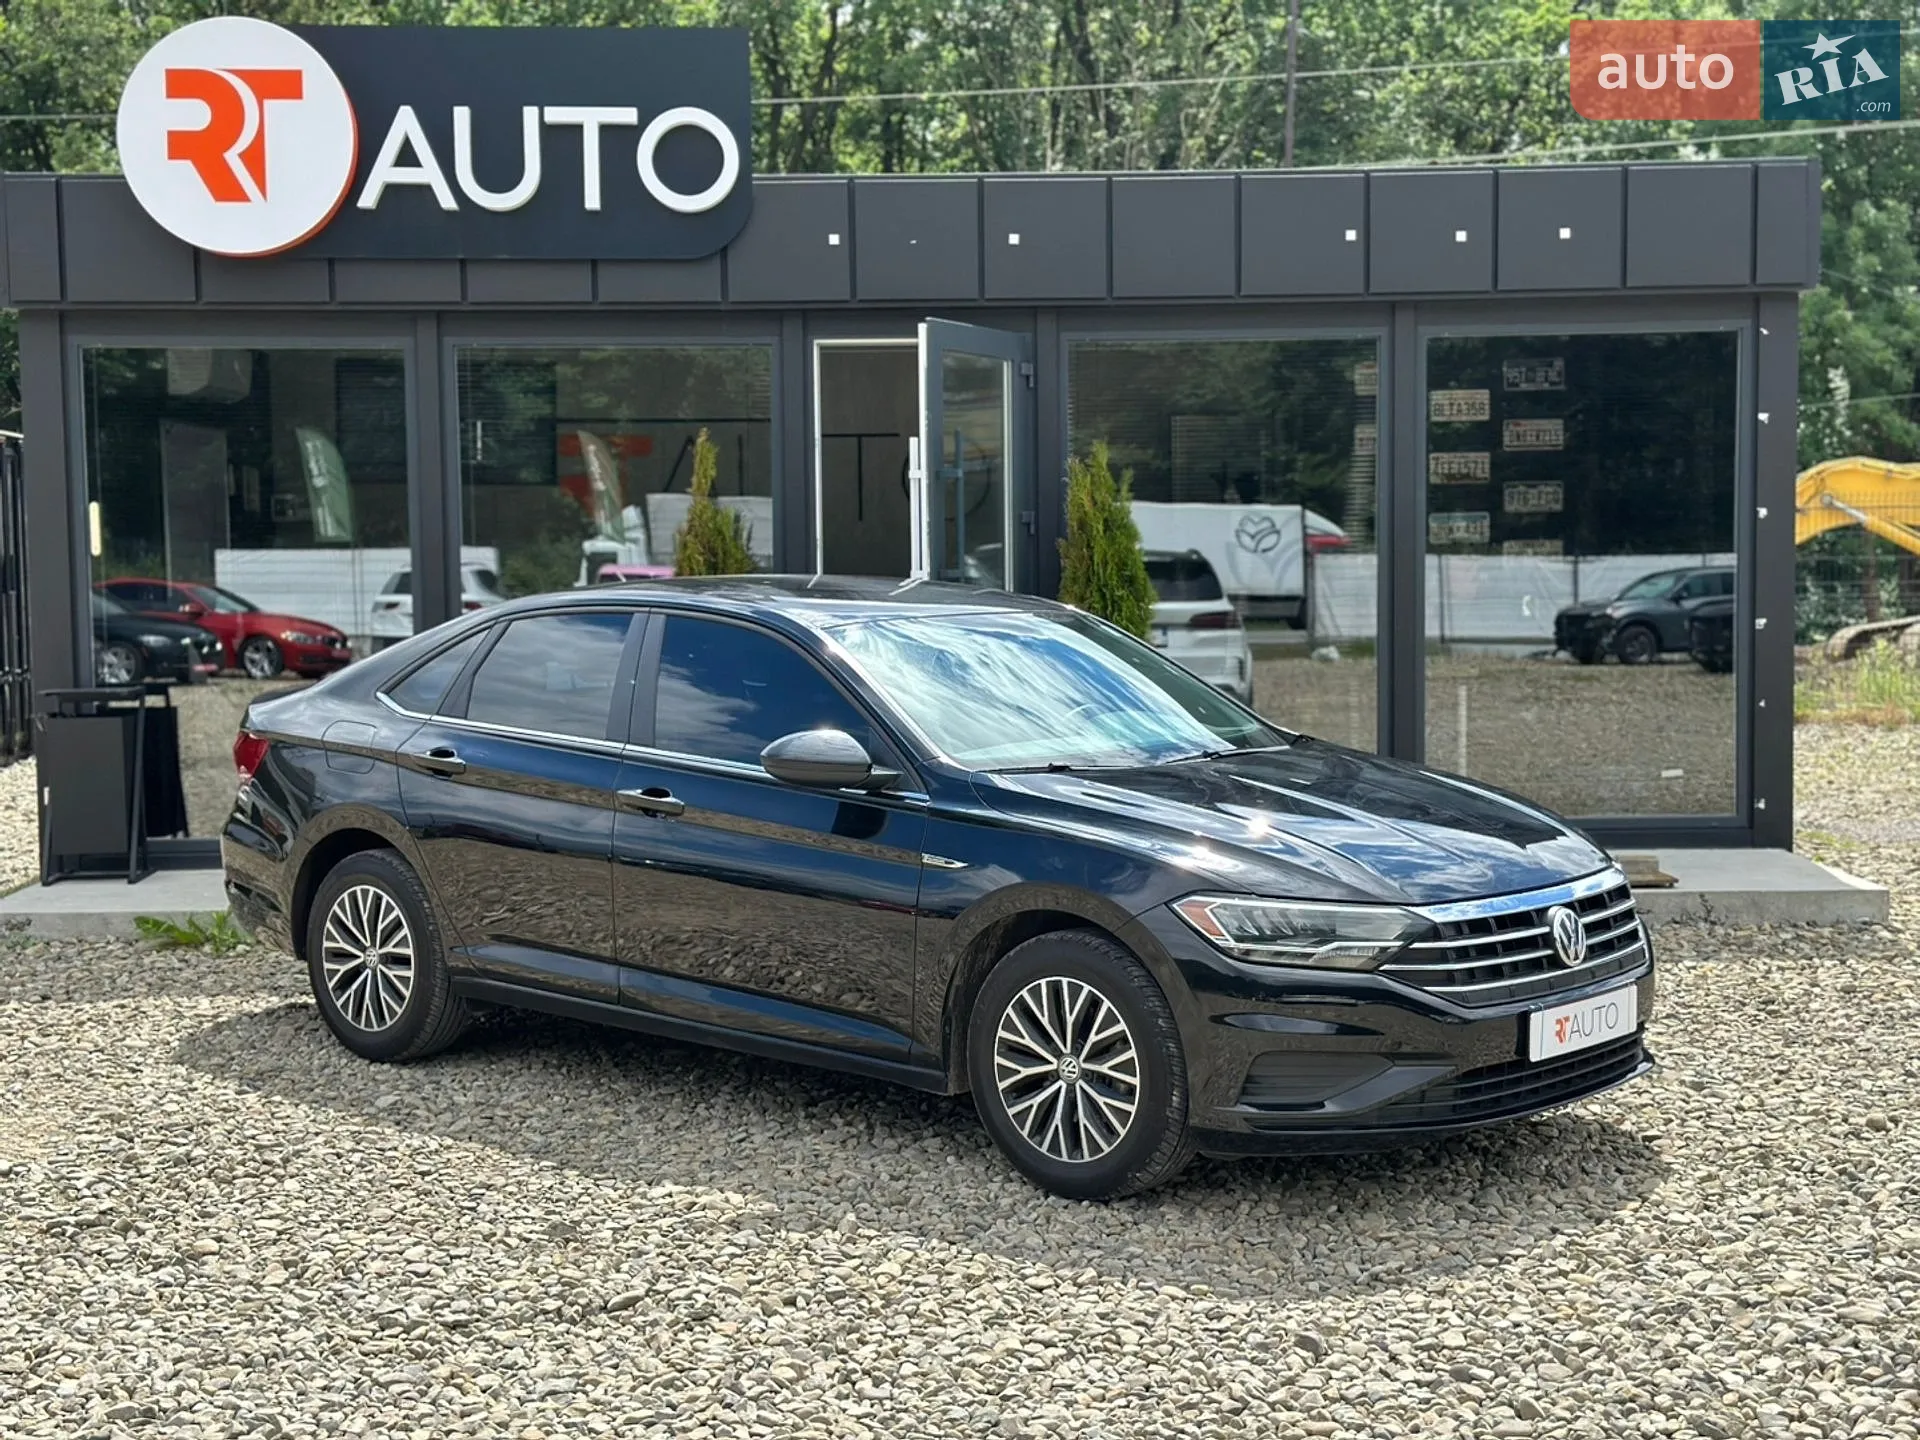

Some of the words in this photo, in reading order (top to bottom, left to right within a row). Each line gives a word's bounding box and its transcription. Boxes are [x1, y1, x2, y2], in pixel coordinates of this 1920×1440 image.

[165, 68, 303, 203] RT
[357, 105, 739, 213] AUTO
[1554, 1015, 1570, 1043] RT
[1568, 1002, 1619, 1042] AUTO
